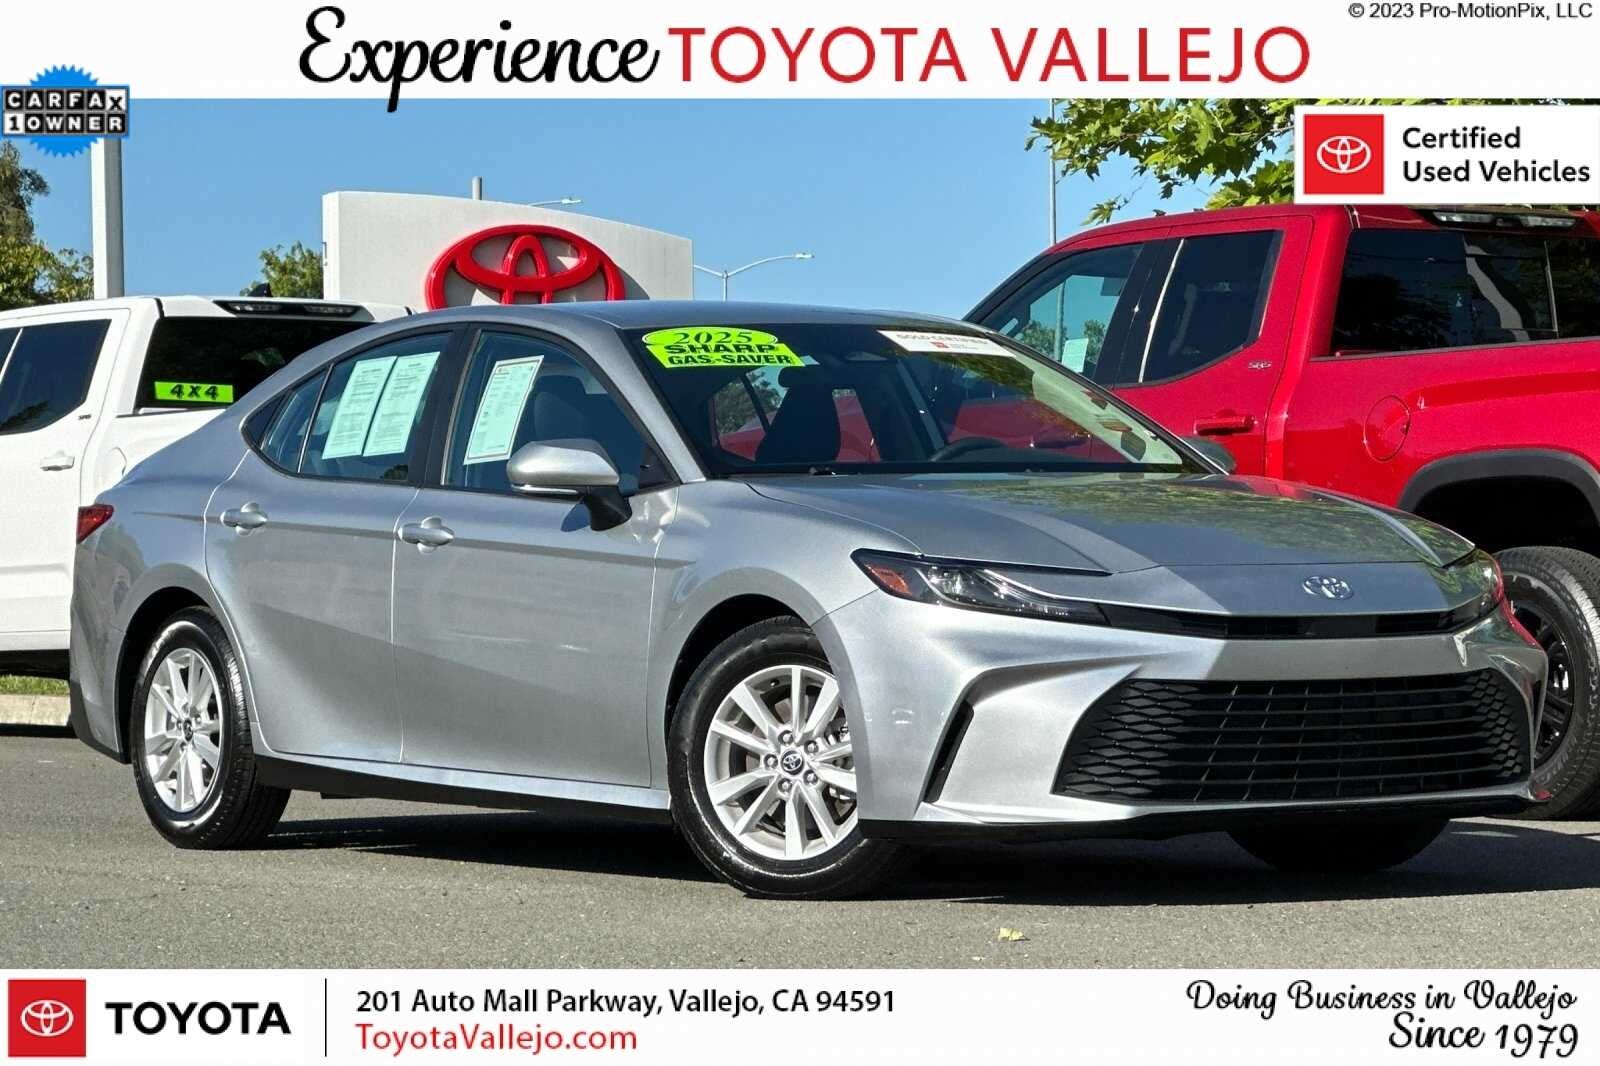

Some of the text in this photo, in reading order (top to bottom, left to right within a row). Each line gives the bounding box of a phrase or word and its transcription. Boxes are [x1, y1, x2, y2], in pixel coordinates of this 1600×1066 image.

[673, 331, 753, 345] 2025
[663, 343, 776, 355] SHARP
[668, 353, 792, 365] GAS-SAVER
